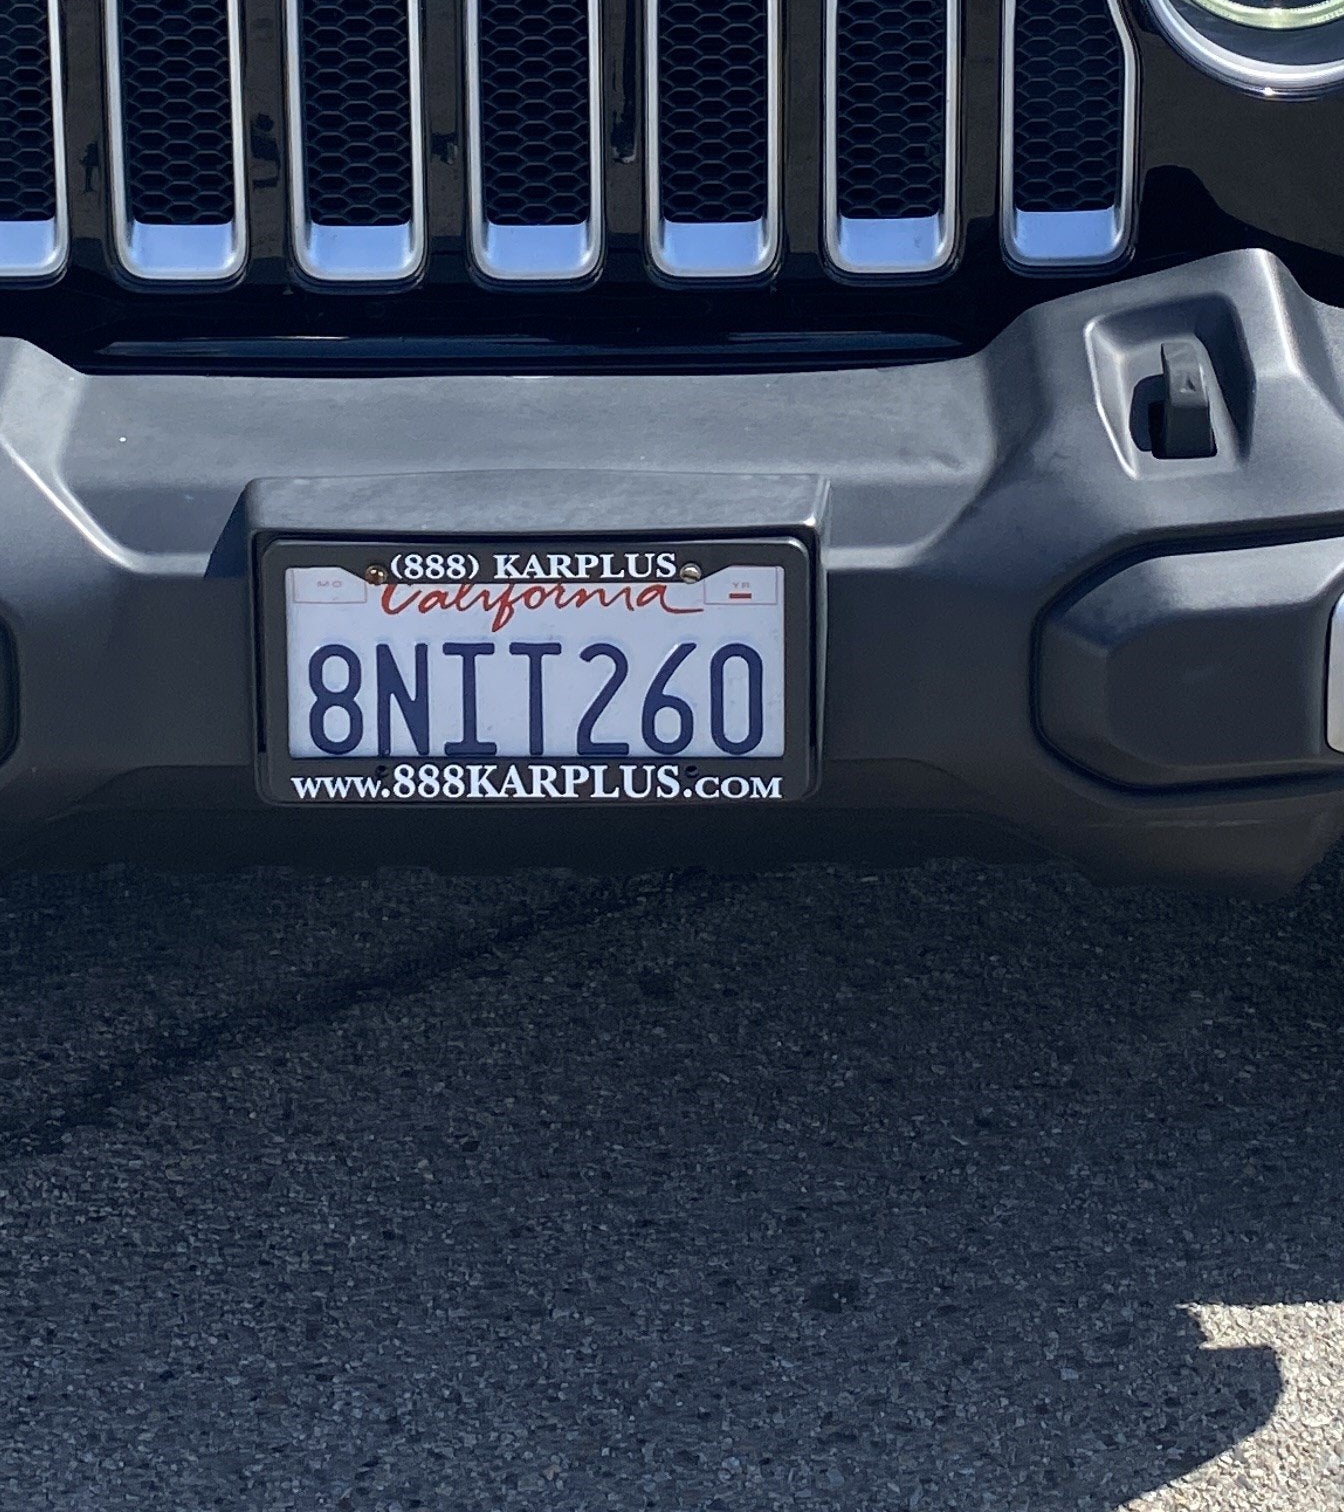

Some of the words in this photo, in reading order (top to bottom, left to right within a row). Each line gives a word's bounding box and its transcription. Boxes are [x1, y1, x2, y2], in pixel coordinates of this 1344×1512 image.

[390, 552, 480, 580] (888)
[494, 552, 678, 580] KARPLUS
[381, 583, 705, 633] California
[307, 641, 765, 757] 8NIT260
